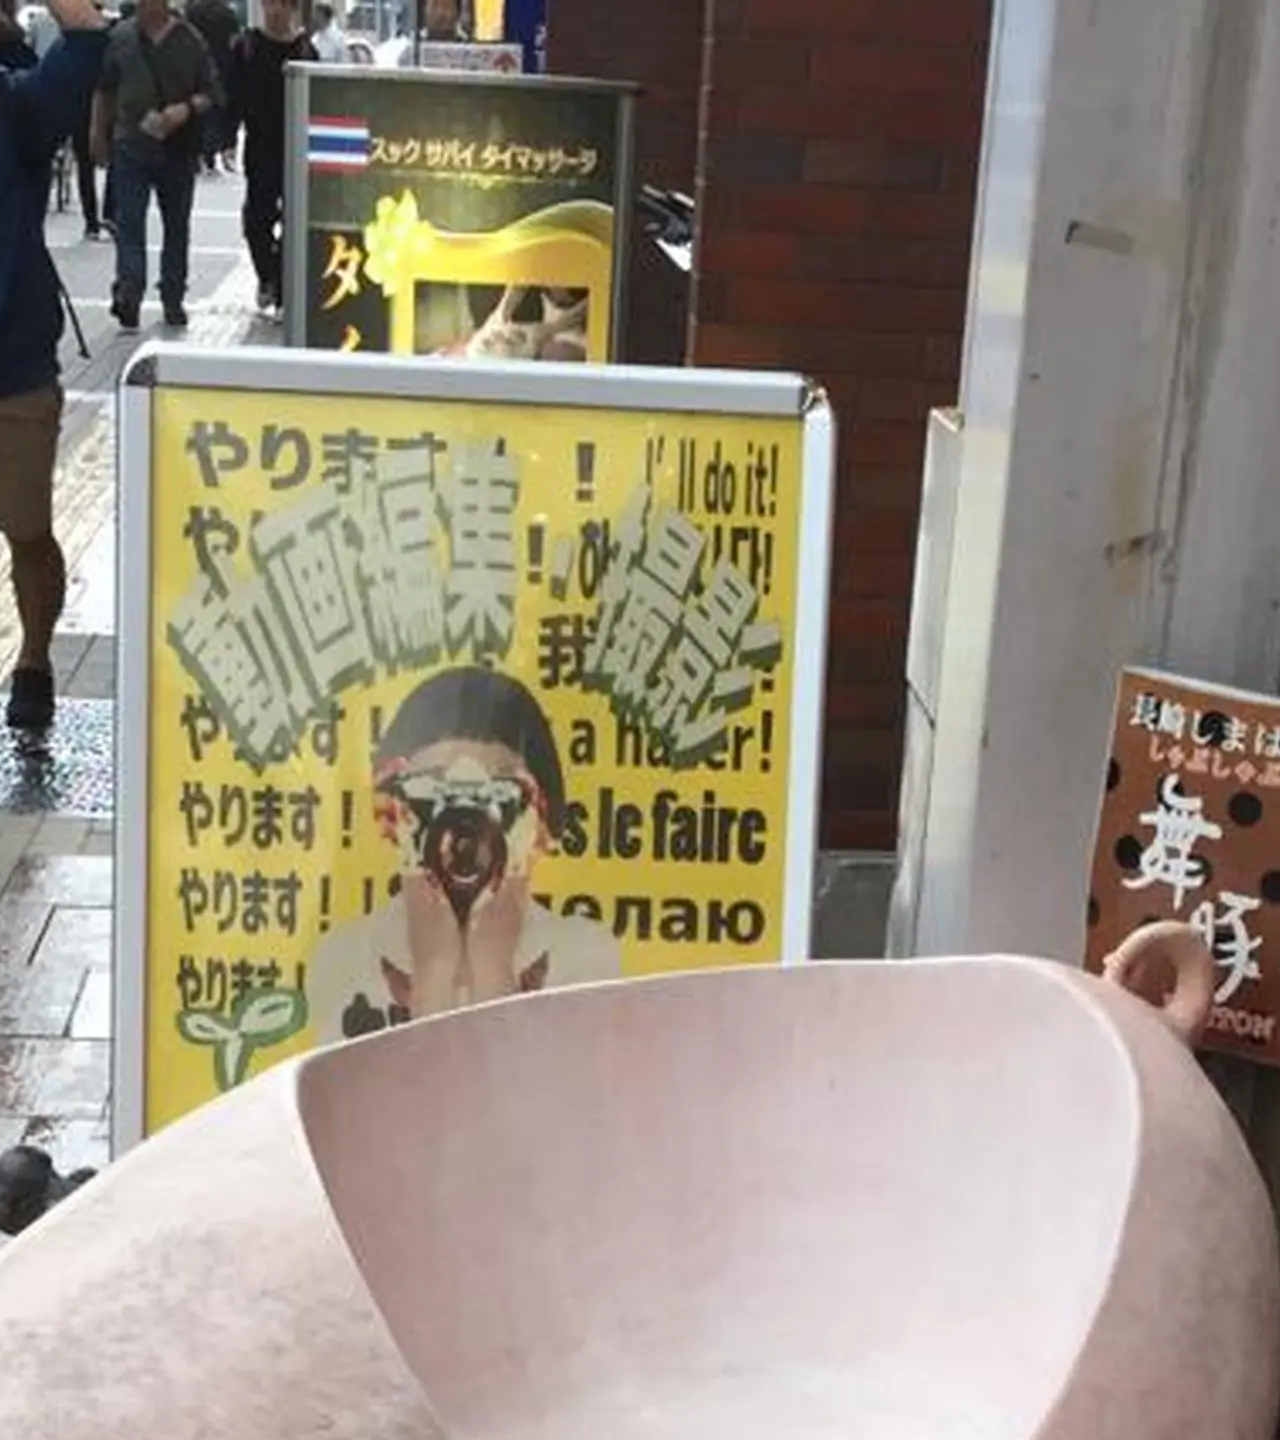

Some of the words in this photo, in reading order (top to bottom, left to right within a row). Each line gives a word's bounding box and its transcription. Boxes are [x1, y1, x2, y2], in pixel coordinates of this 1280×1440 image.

[704, 440, 737, 516] do
[745, 441, 780, 518] it!
[179, 781, 354, 851] やります！
[596, 786, 642, 860] le
[650, 790, 767, 865] faire
[179, 867, 332, 937] やります！
